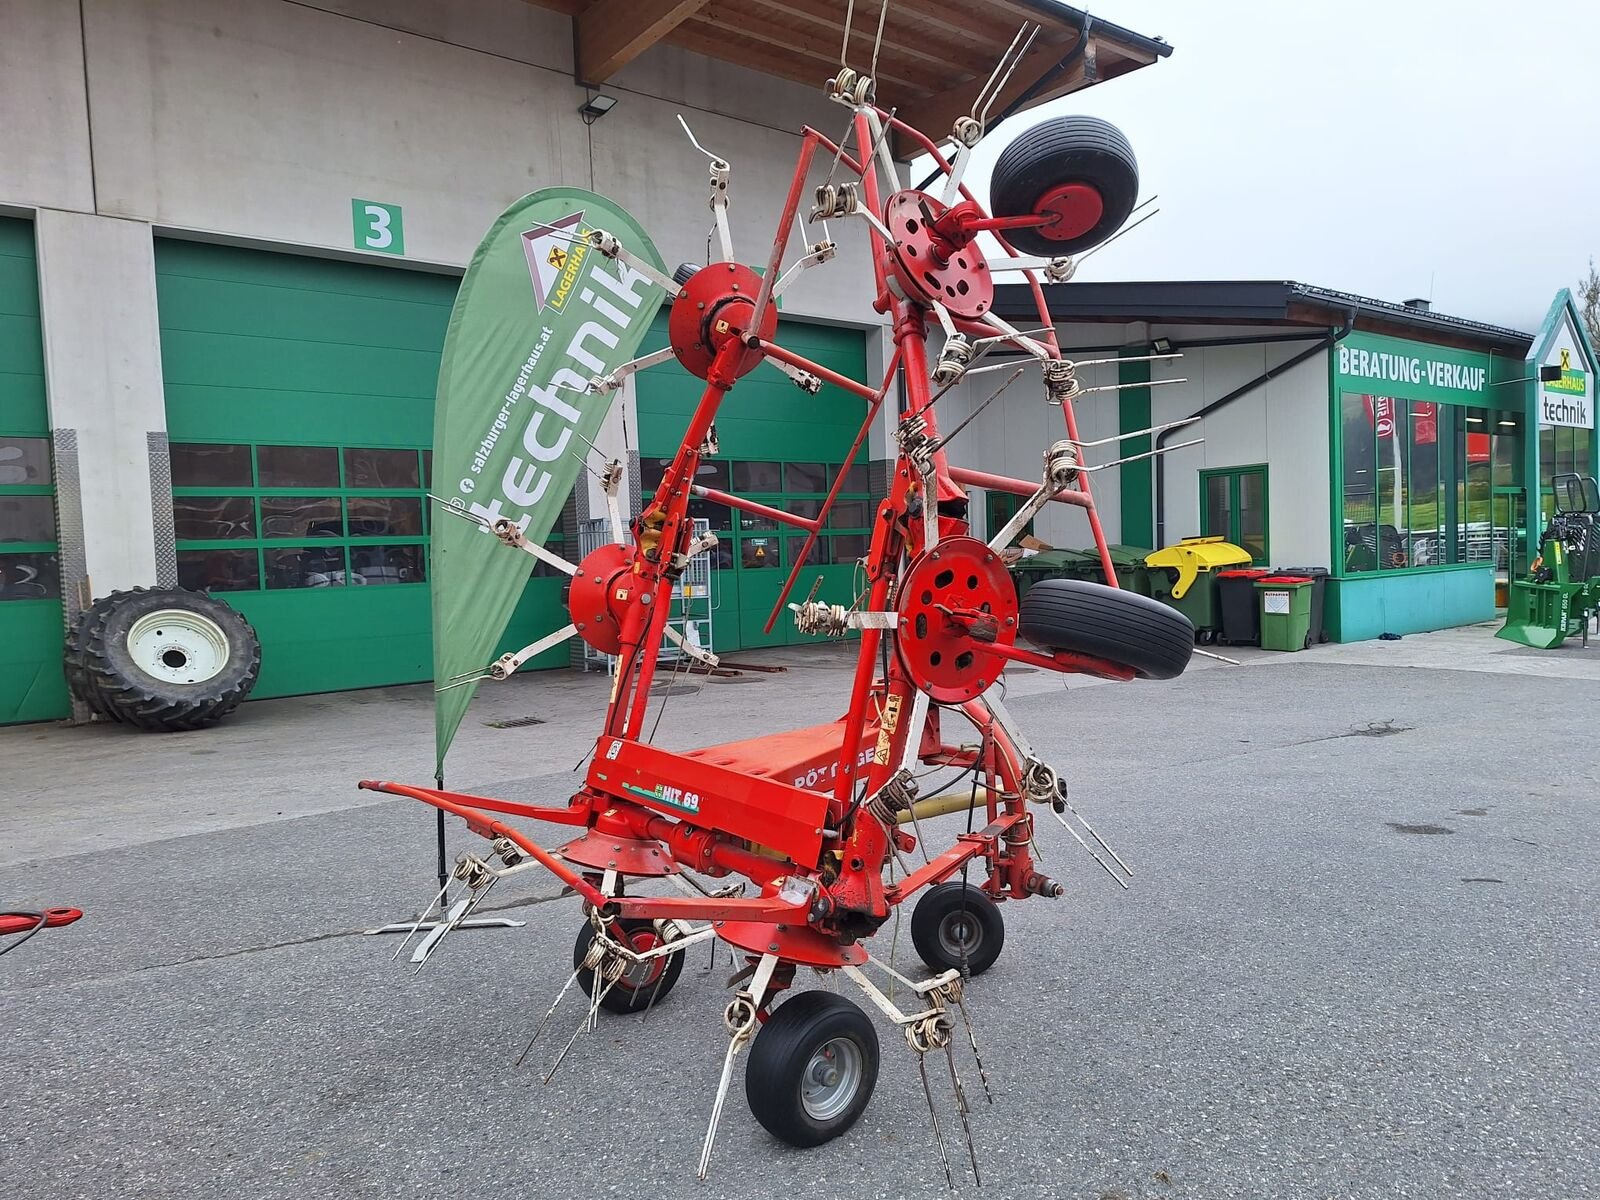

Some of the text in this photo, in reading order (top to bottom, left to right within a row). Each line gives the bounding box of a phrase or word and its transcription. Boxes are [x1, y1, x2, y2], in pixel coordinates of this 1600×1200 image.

[364, 206, 394, 248] 3
[1339, 348, 1486, 392] BERATUNG-VERKAUF
[470, 325, 554, 475] salzburger-lagerhaus.at
[1543, 396, 1587, 425] technik
[683, 791, 699, 810] 69
